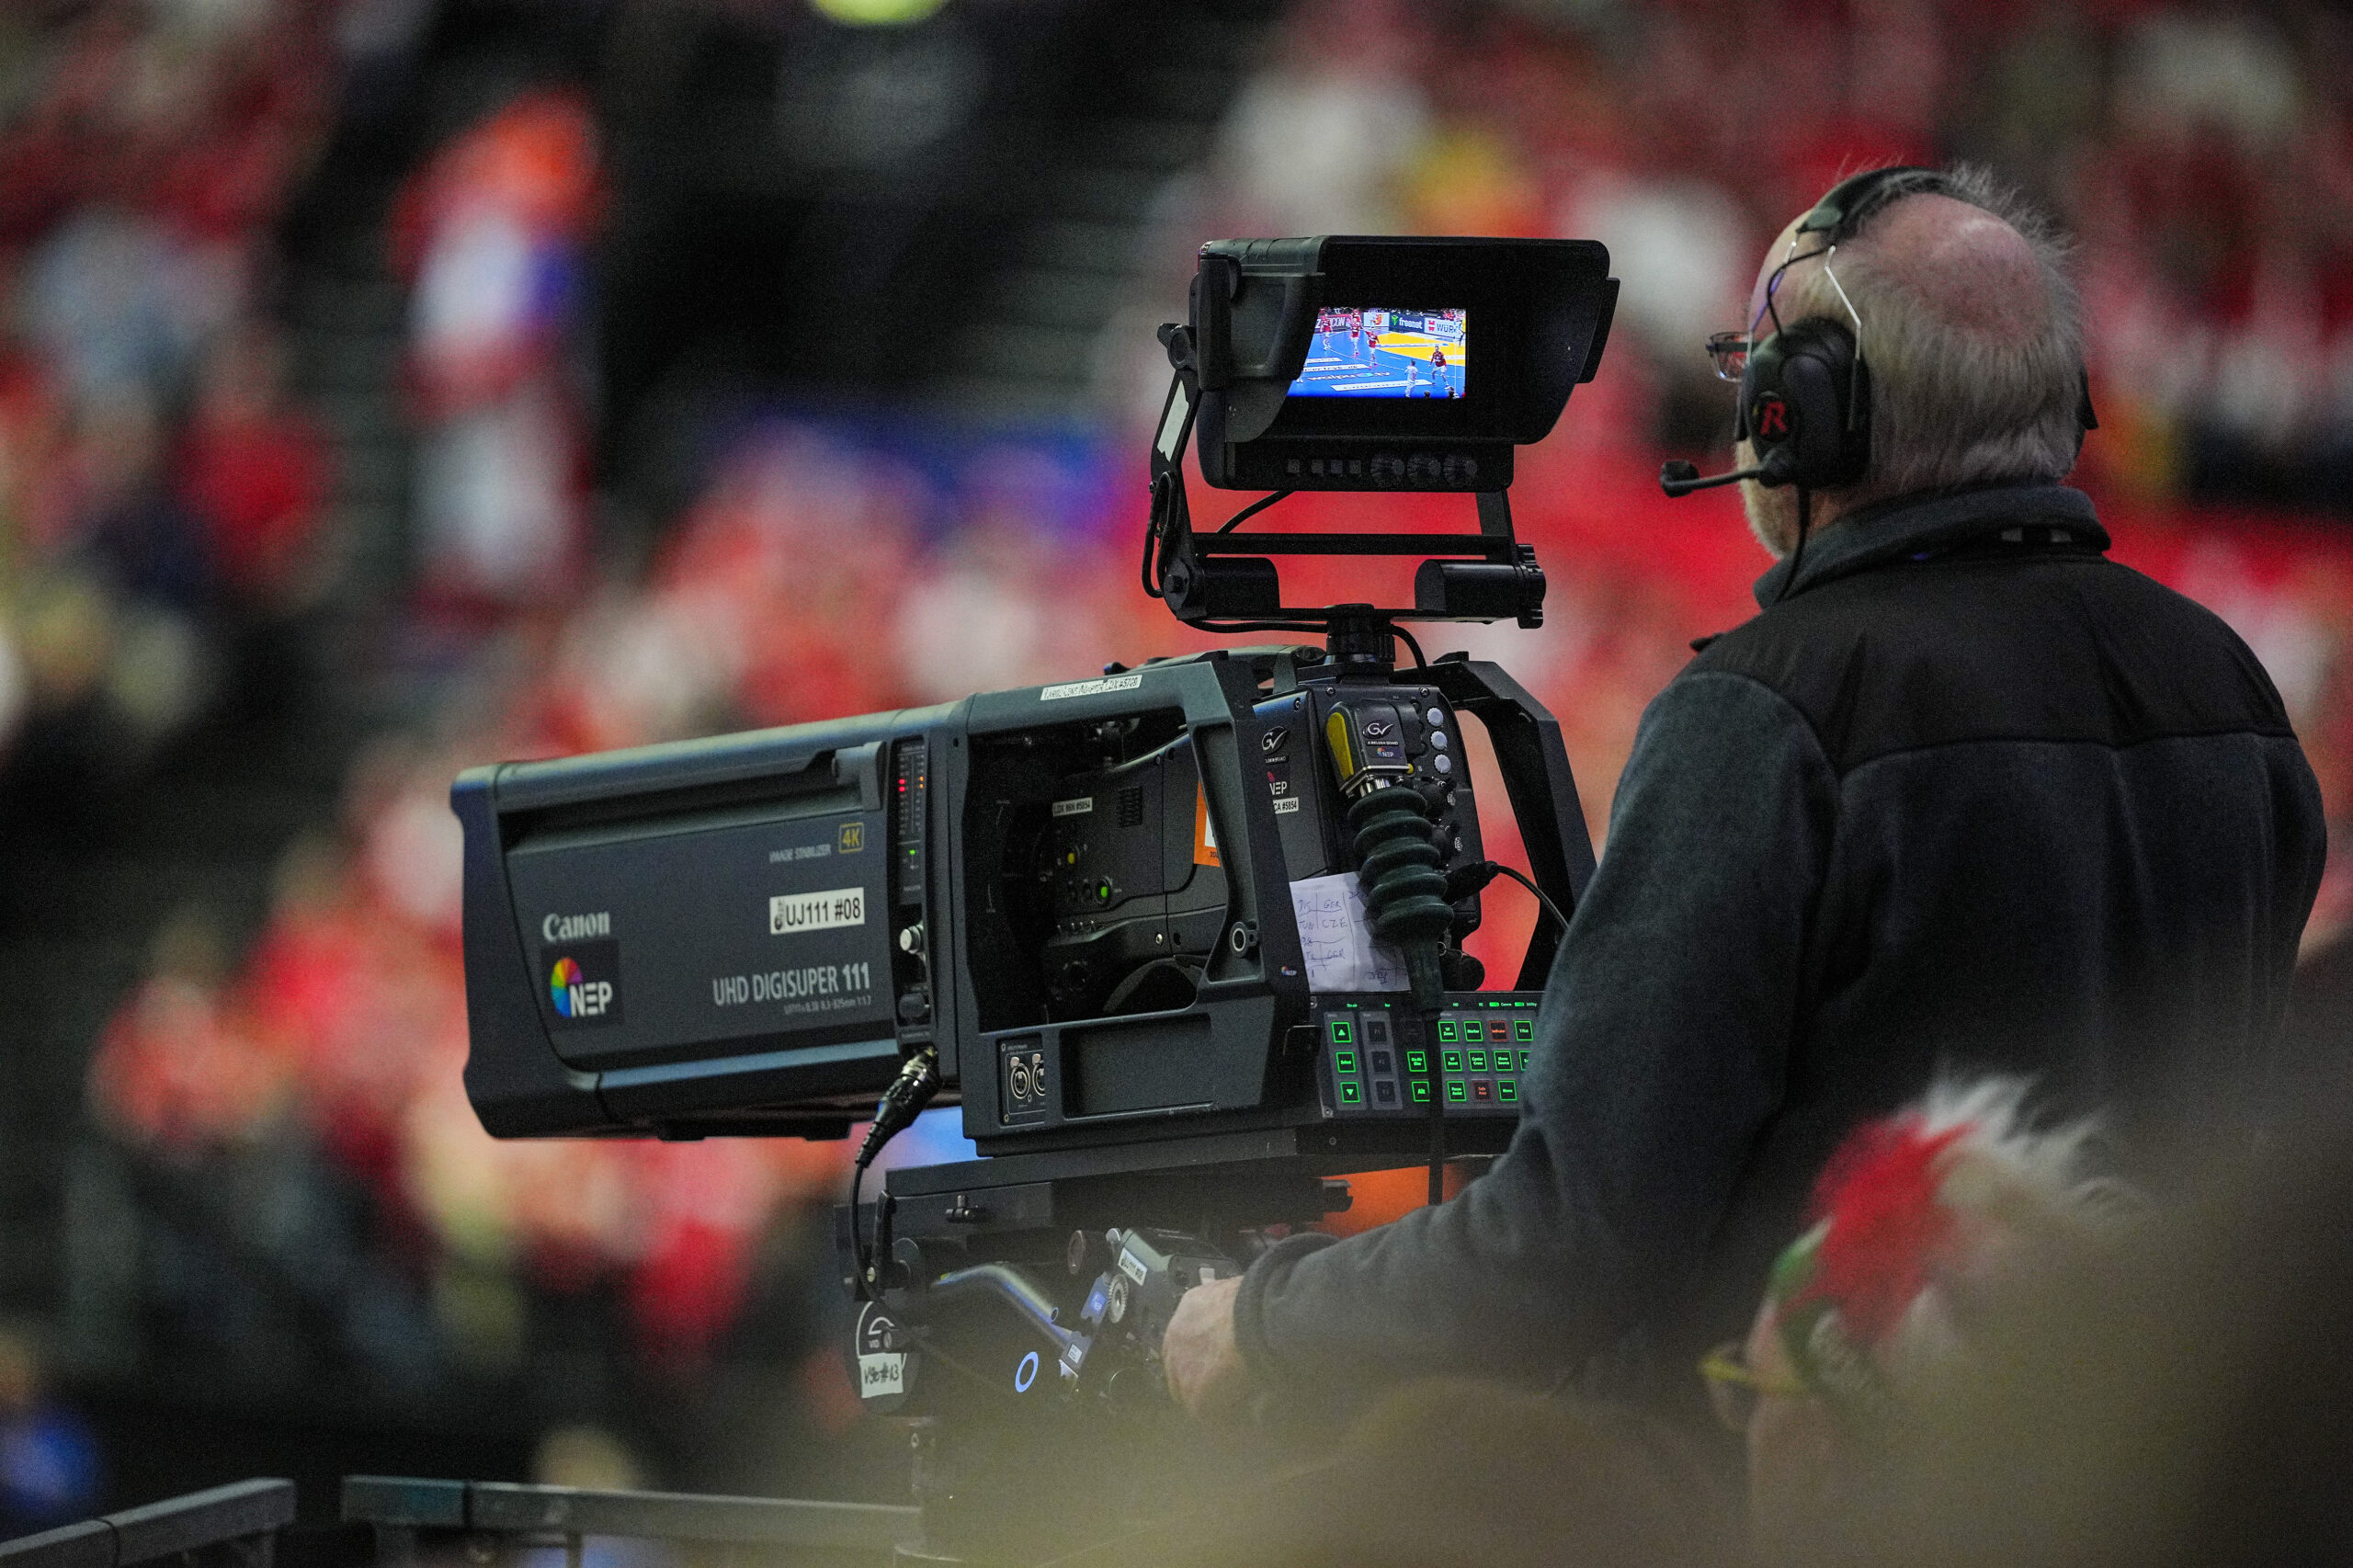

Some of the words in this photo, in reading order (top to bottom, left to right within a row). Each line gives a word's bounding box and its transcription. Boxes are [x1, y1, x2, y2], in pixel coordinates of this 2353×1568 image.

[1399, 317, 1423, 329] freenet
[1761, 402, 1787, 435] R
[842, 829, 860, 846] 4K
[543, 911, 610, 942] Canon
[786, 901, 829, 926] UJ111
[835, 897, 861, 921] #08
[569, 981, 613, 1017] NEP
[713, 975, 749, 1006] UHD
[752, 966, 839, 1003] DIGISUPER
[842, 961, 870, 991] 111
